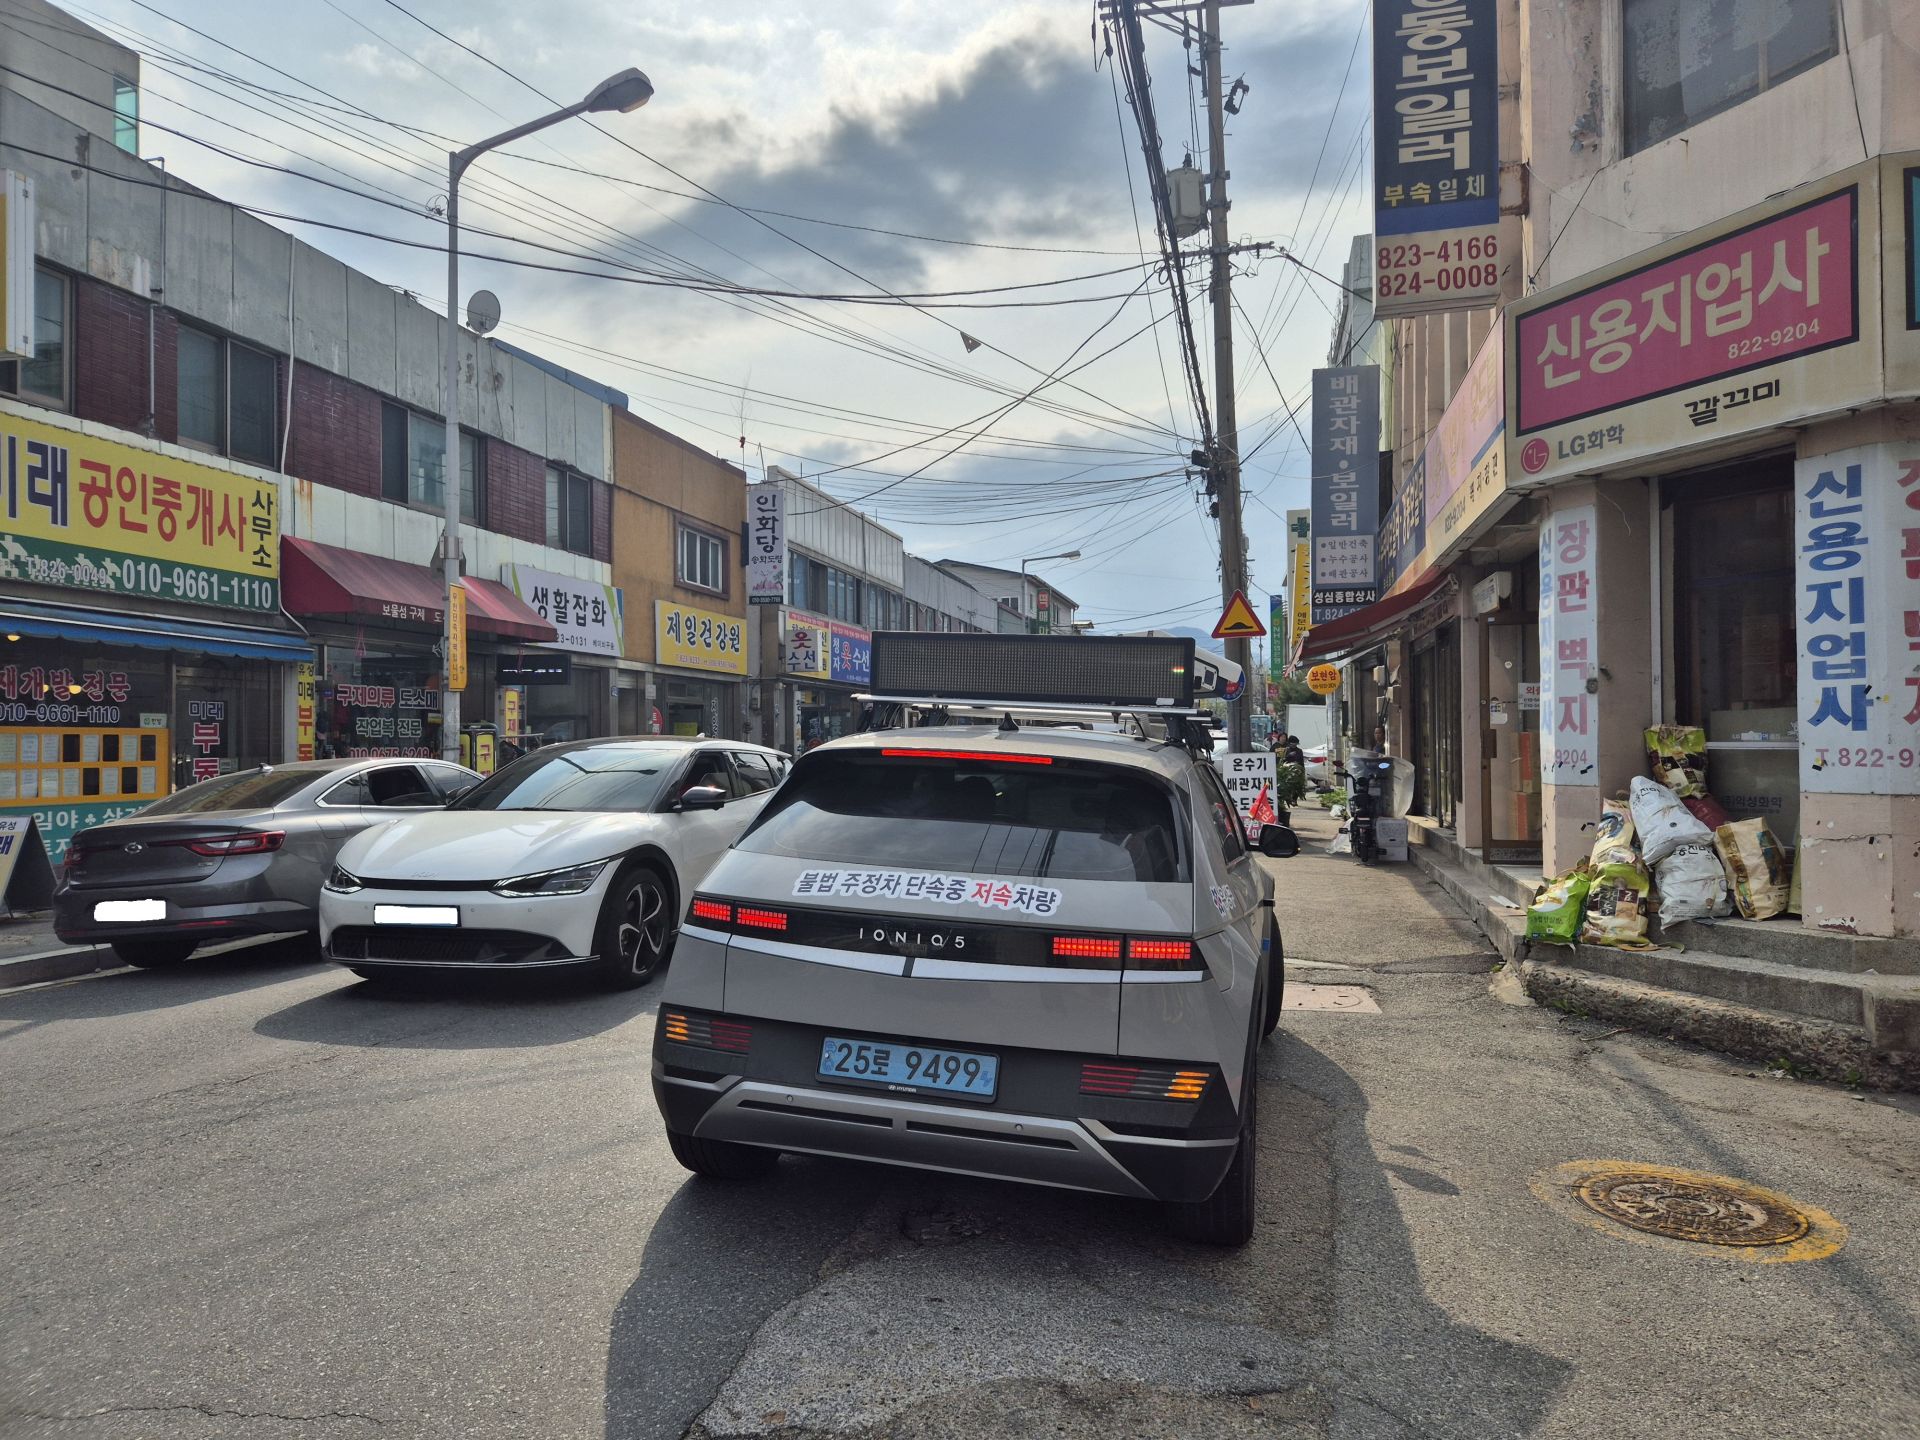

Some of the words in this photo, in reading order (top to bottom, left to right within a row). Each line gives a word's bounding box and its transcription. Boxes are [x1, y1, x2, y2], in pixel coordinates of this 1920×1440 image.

[1378, 235, 1498, 270] 823-4166
[1378, 263, 1498, 298] 824-0008
[1537, 226, 1830, 389] 신용지업사
[1728, 318, 1820, 360] 822-9204
[1684, 379, 1781, 427] 깔끄미
[1558, 424, 1624, 460] LG화학
[79, 458, 247, 552] 공인중개사
[251, 490, 273, 568] 사무소
[756, 495, 779, 553] 인화당
[1328, 539, 1369, 550] 일반건축
[1328, 553, 1368, 564] 누수공사
[122, 558, 272, 609] 010-9661-1110
[1314, 590, 1376, 604] 성심종합상사
[1803, 464, 1870, 731] 신용지업사
[382, 604, 407, 619] 보물섬
[409, 606, 425, 621] 구제
[532, 586, 607, 627] 생활잡화
[667, 611, 740, 653] 제일건강원
[791, 632, 812, 649] 옷
[787, 650, 816, 671] 수선
[189, 701, 224, 720] 미래
[399, 688, 439, 710] 도소매
[356, 717, 395, 737] 작업복
[397, 718, 422, 737] 전문
[1233, 758, 1267, 771] 온수기
[1227, 777, 1274, 791] 배관자재
[799, 873, 838, 893] 불법
[840, 873, 901, 896] 주정차
[905, 876, 967, 901] 단속중
[858, 927, 945, 947] IONIQ
[955, 935, 965, 949] 5
[835, 1042, 891, 1077] 25로
[905, 1050, 981, 1088] 9499
